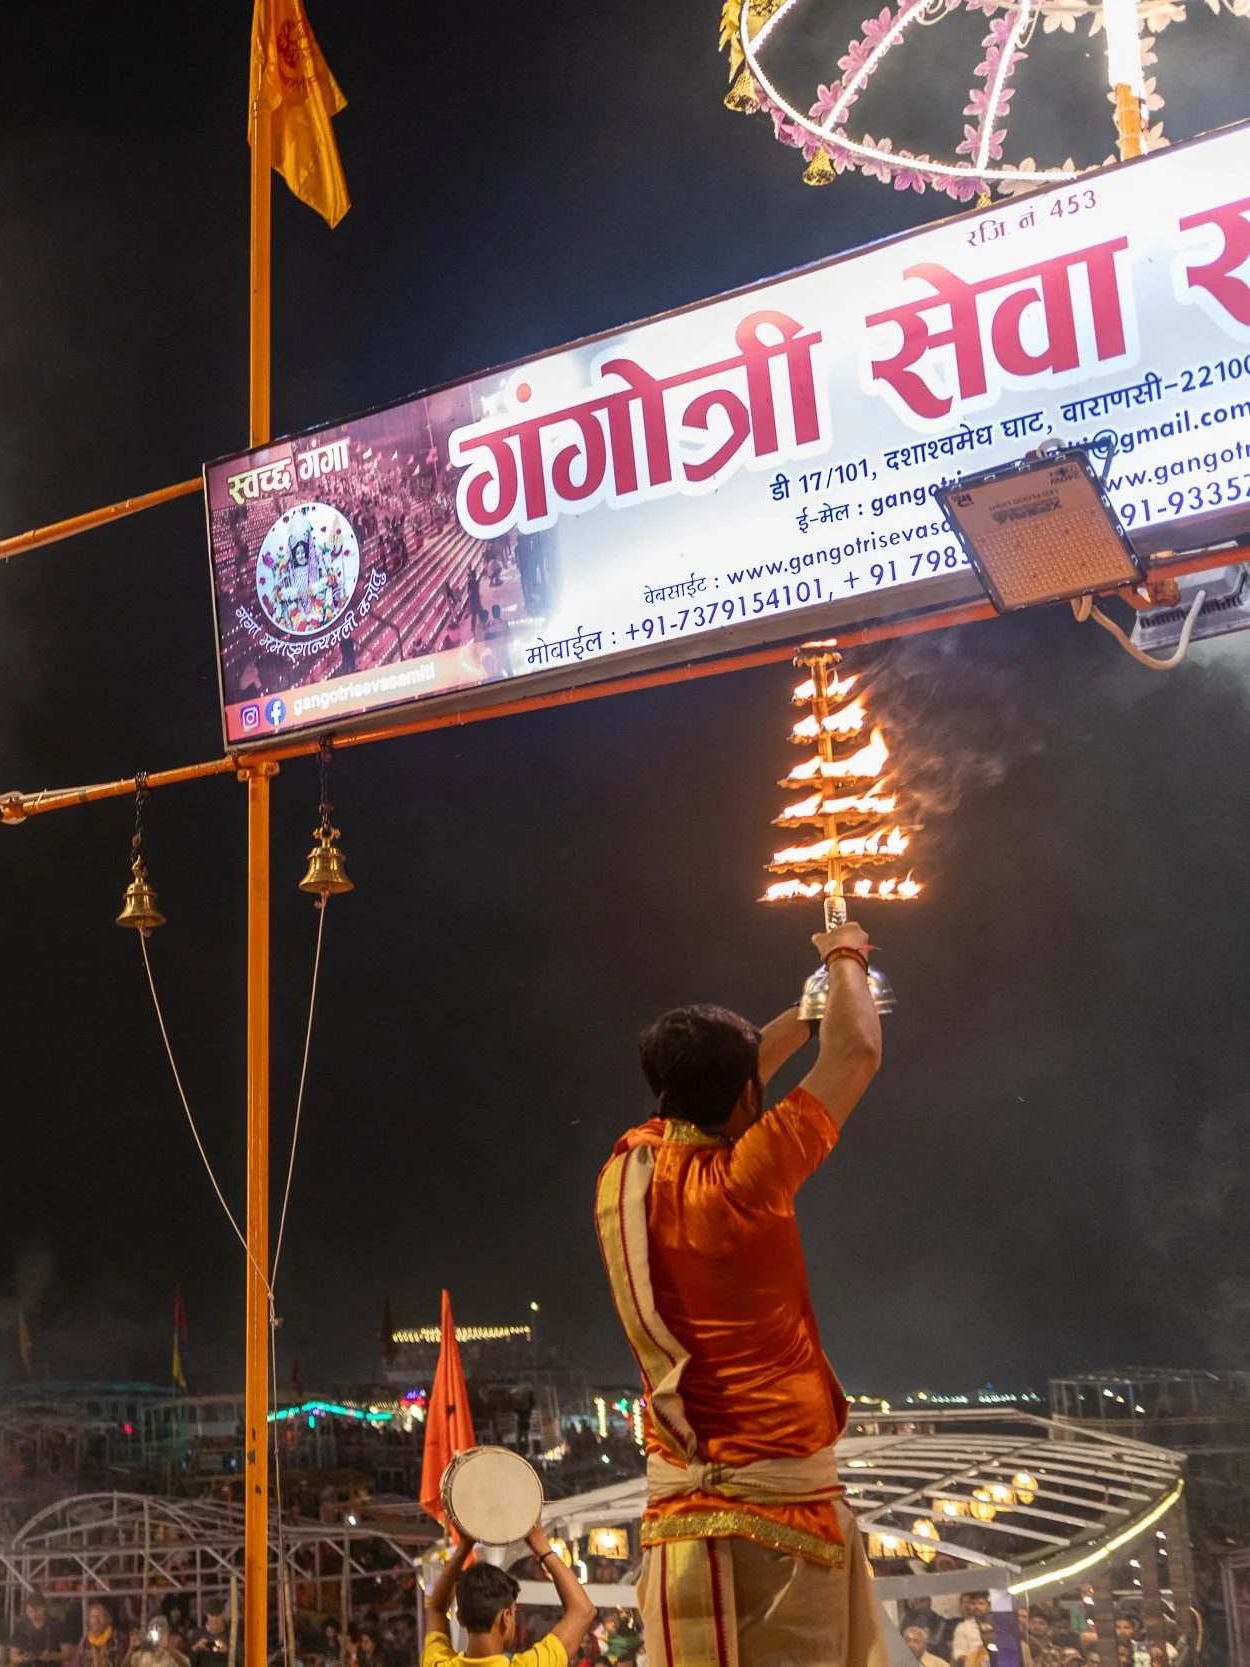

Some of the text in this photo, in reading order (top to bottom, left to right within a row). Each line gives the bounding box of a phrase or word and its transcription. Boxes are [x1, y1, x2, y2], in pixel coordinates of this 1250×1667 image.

[1050, 190, 1096, 218] 453
[459, 310, 822, 525] गंगोत्री
[865, 235, 1129, 419] सेवा
[227, 438, 350, 505] स्वच्छ गंगा
[770, 472, 790, 501] डी
[798, 458, 877, 494] 17/101,
[884, 424, 994, 471] दशाश्वमेध
[1000, 411, 1053, 439] घाट,
[796, 502, 850, 534] ई-मेल
[643, 572, 707, 605] वेबसाईट
[525, 625, 602, 664] मोबाईल
